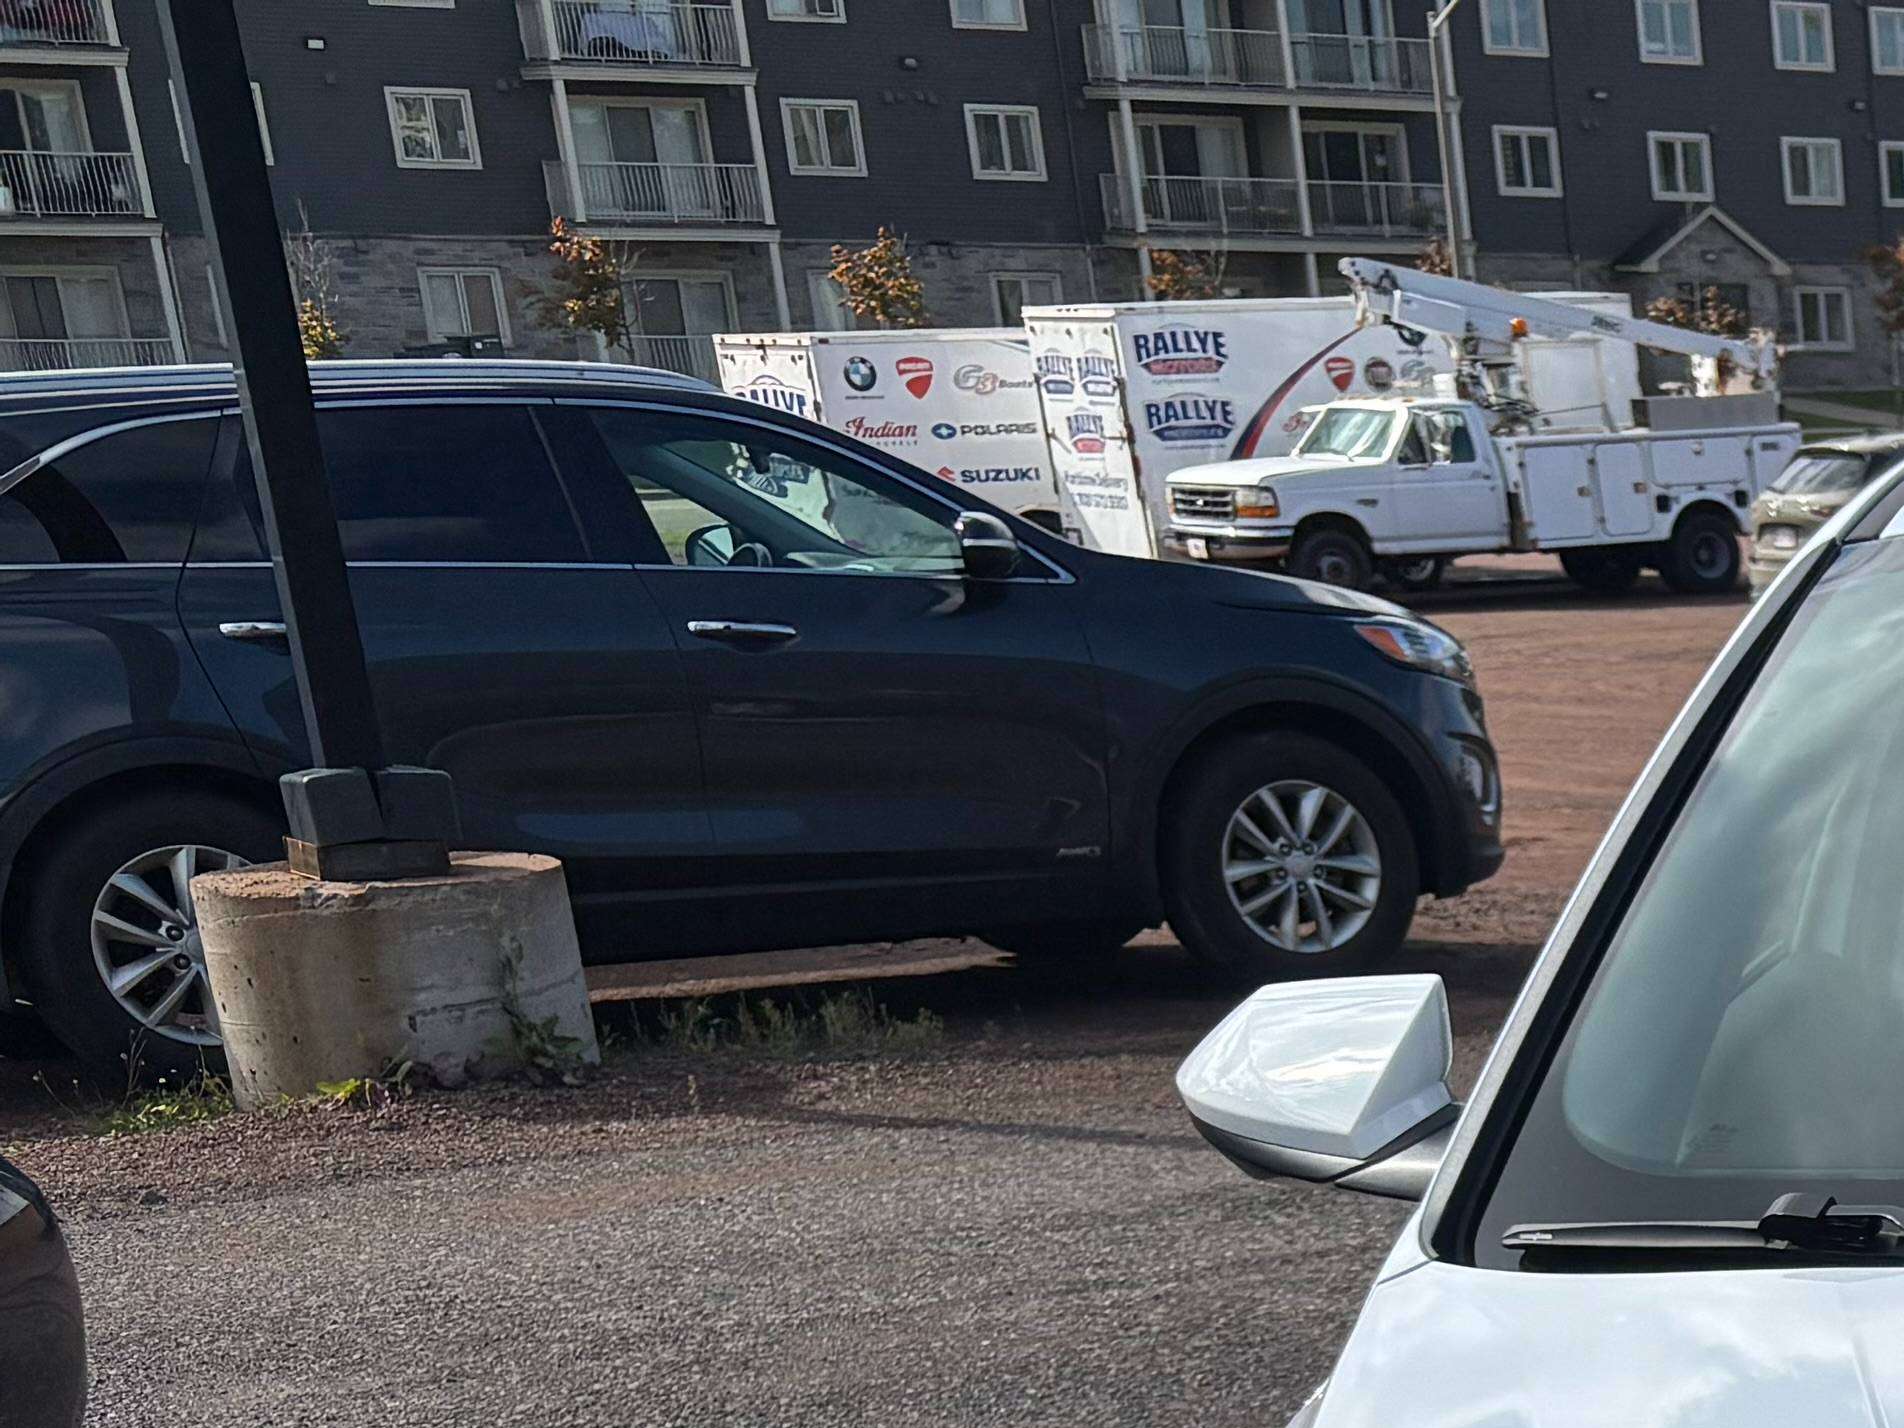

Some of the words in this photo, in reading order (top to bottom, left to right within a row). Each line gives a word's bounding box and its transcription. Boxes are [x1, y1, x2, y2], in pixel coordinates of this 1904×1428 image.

[1133, 330, 1228, 363] RALLYE
[1145, 399, 1235, 430] RALLYE
[845, 416, 918, 440] Indian
[960, 422, 1038, 437] POLARIS
[960, 467, 1041, 484] SUZUKI
